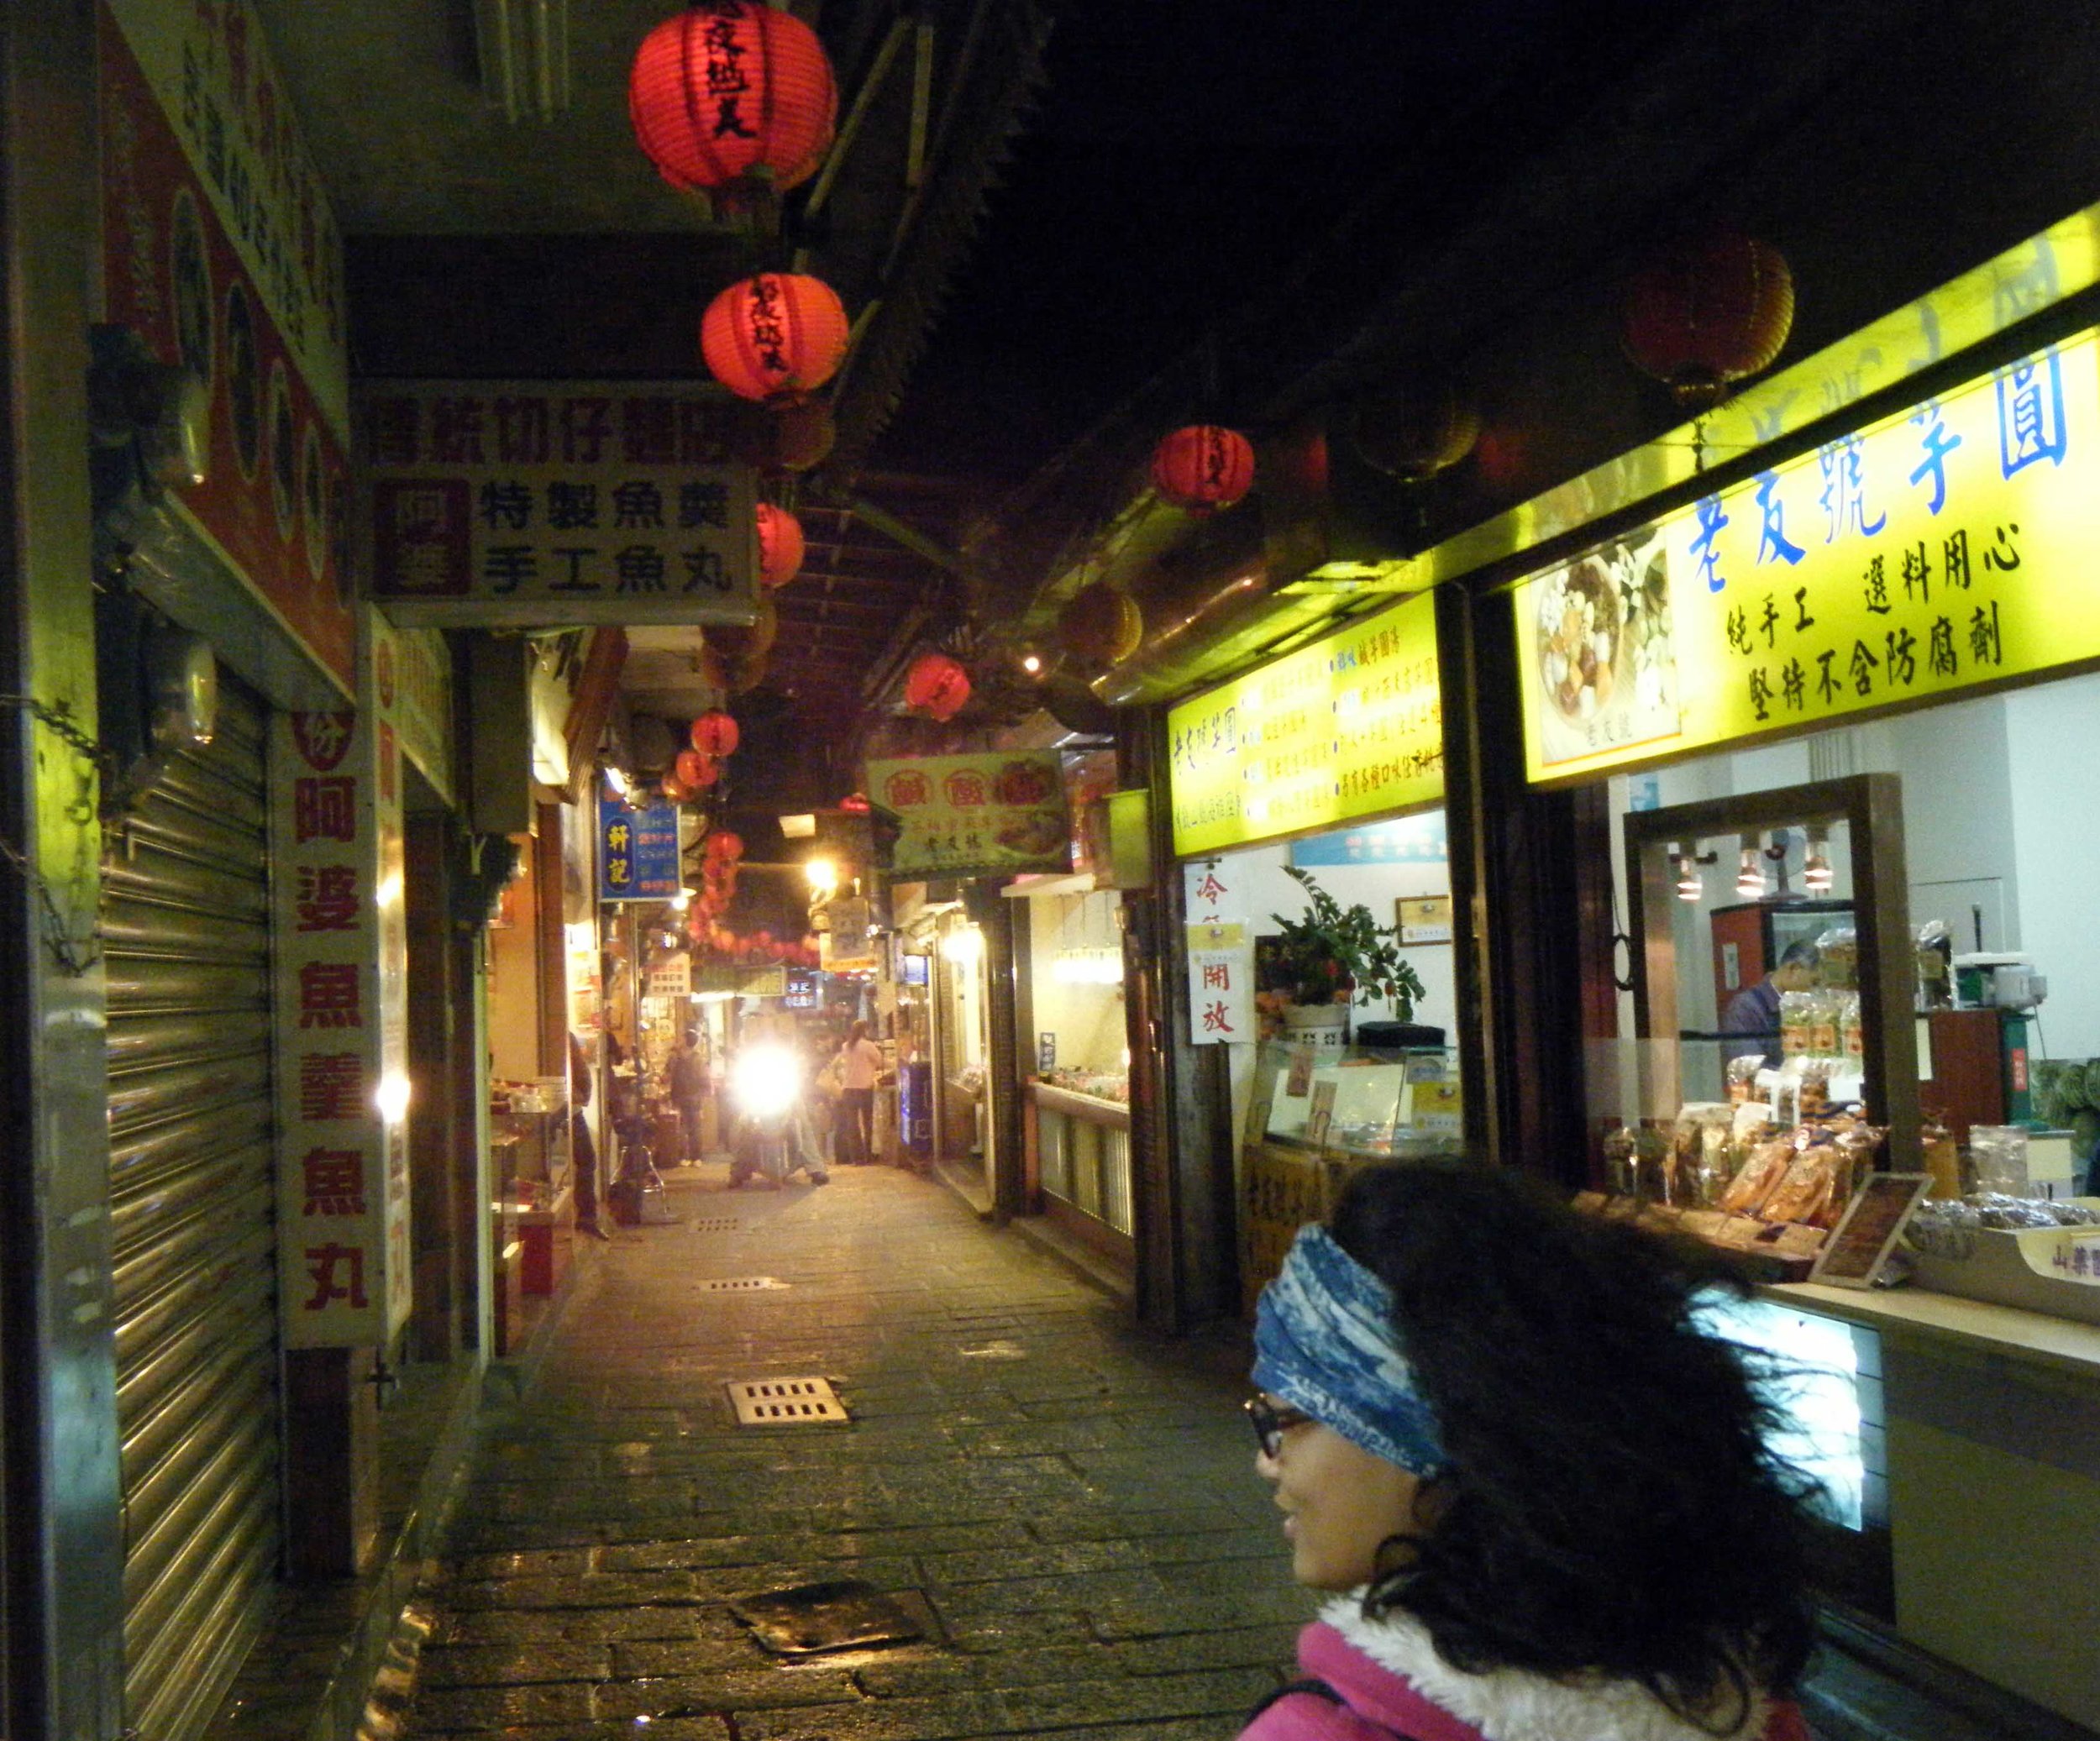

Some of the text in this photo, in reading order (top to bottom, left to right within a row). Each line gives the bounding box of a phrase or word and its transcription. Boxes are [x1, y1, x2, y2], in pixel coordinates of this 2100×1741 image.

[483, 543, 735, 595] 手工魚丸
[1726, 522, 2021, 656] 純手工 選料用心
[1748, 600, 2003, 721] 堅持不含防腐劑
[1196, 873, 1234, 1033] 冷開放
